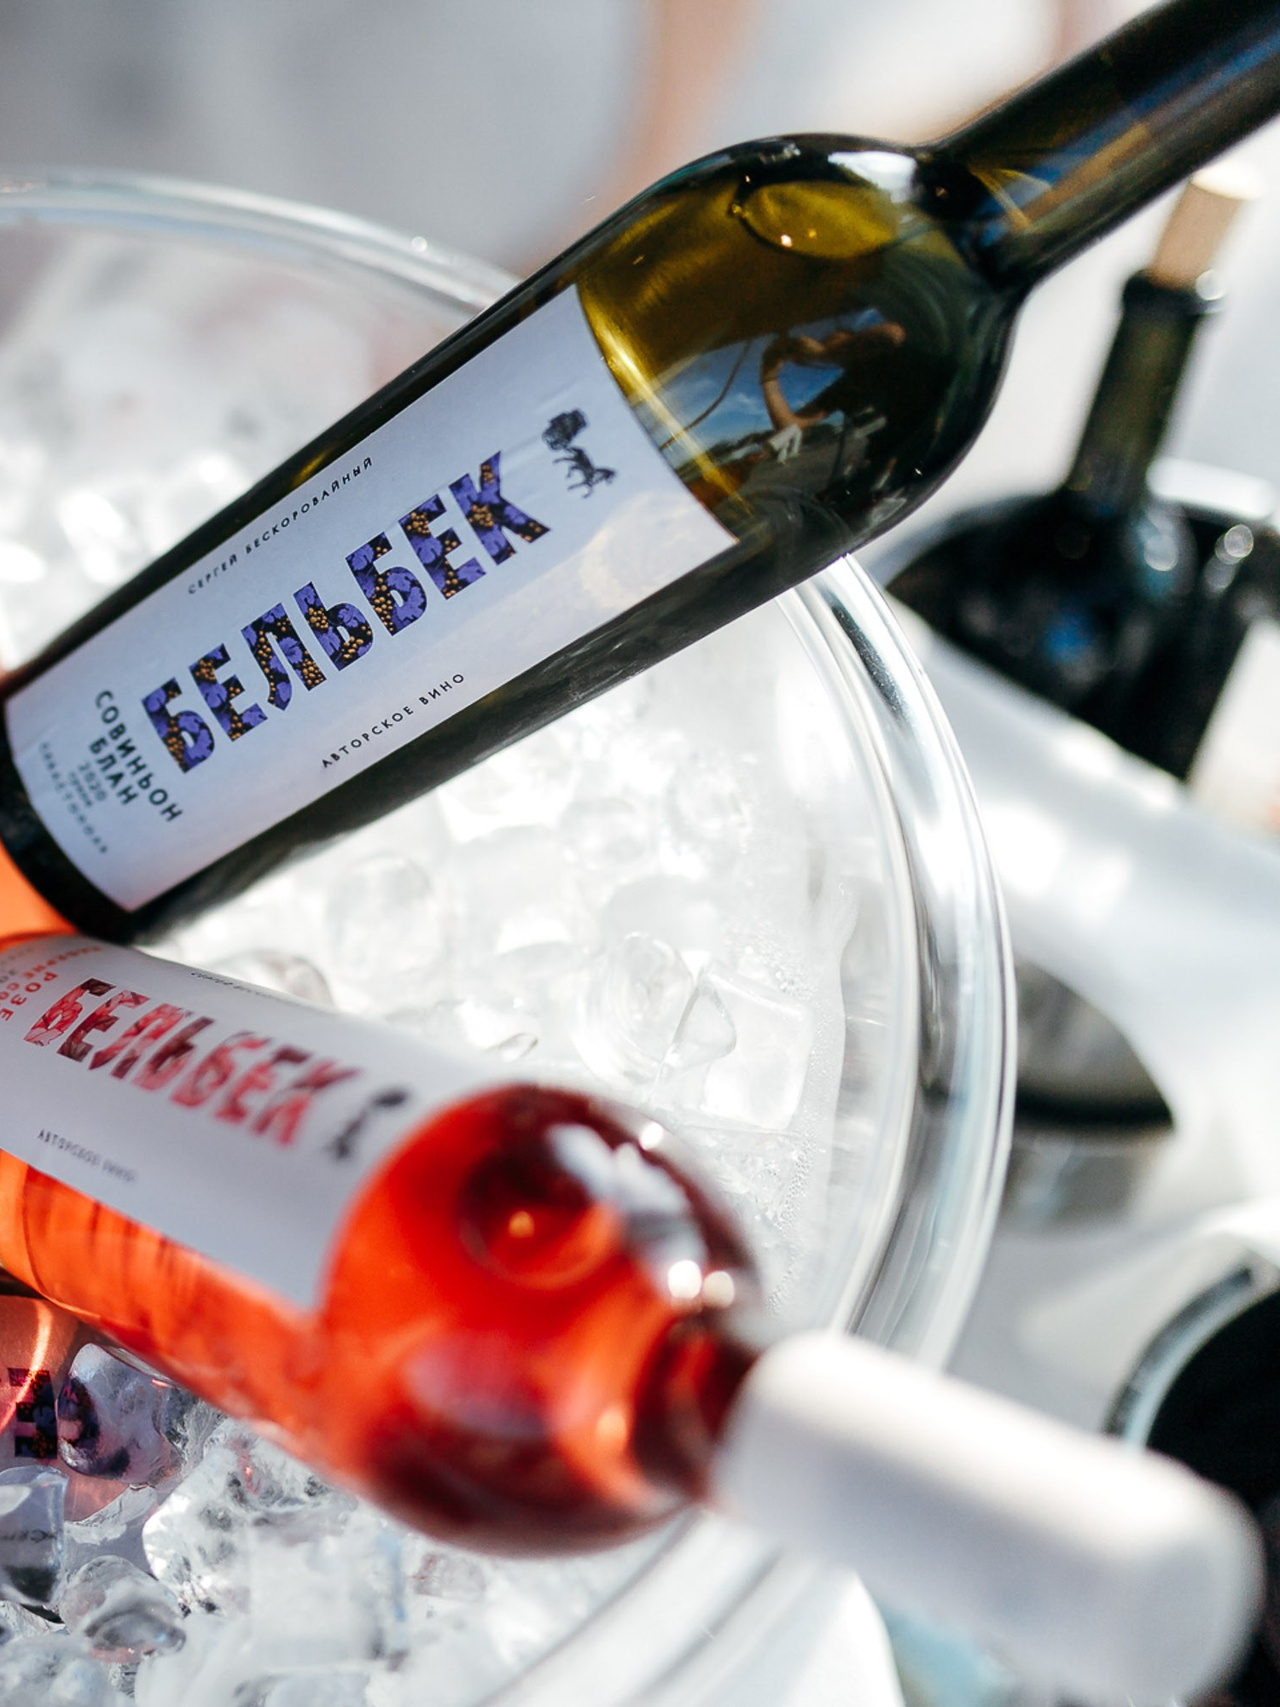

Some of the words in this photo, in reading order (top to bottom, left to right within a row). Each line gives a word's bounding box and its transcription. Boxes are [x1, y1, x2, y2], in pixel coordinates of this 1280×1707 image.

[187, 552, 238, 595] СЕРГЕЙ
[245, 456, 373, 555] БЕСКОРОВАЙНЫЙ
[140, 450, 551, 774] БЕЛЬБЕК
[88, 737, 139, 805] БЛАН
[95, 690, 183, 822] СОВИНЬОН
[322, 705, 414, 768] АВТОРСКОЕ
[418, 673, 464, 706] ВИНО
[22, 977, 363, 1148] БЕЛЬБЕК
